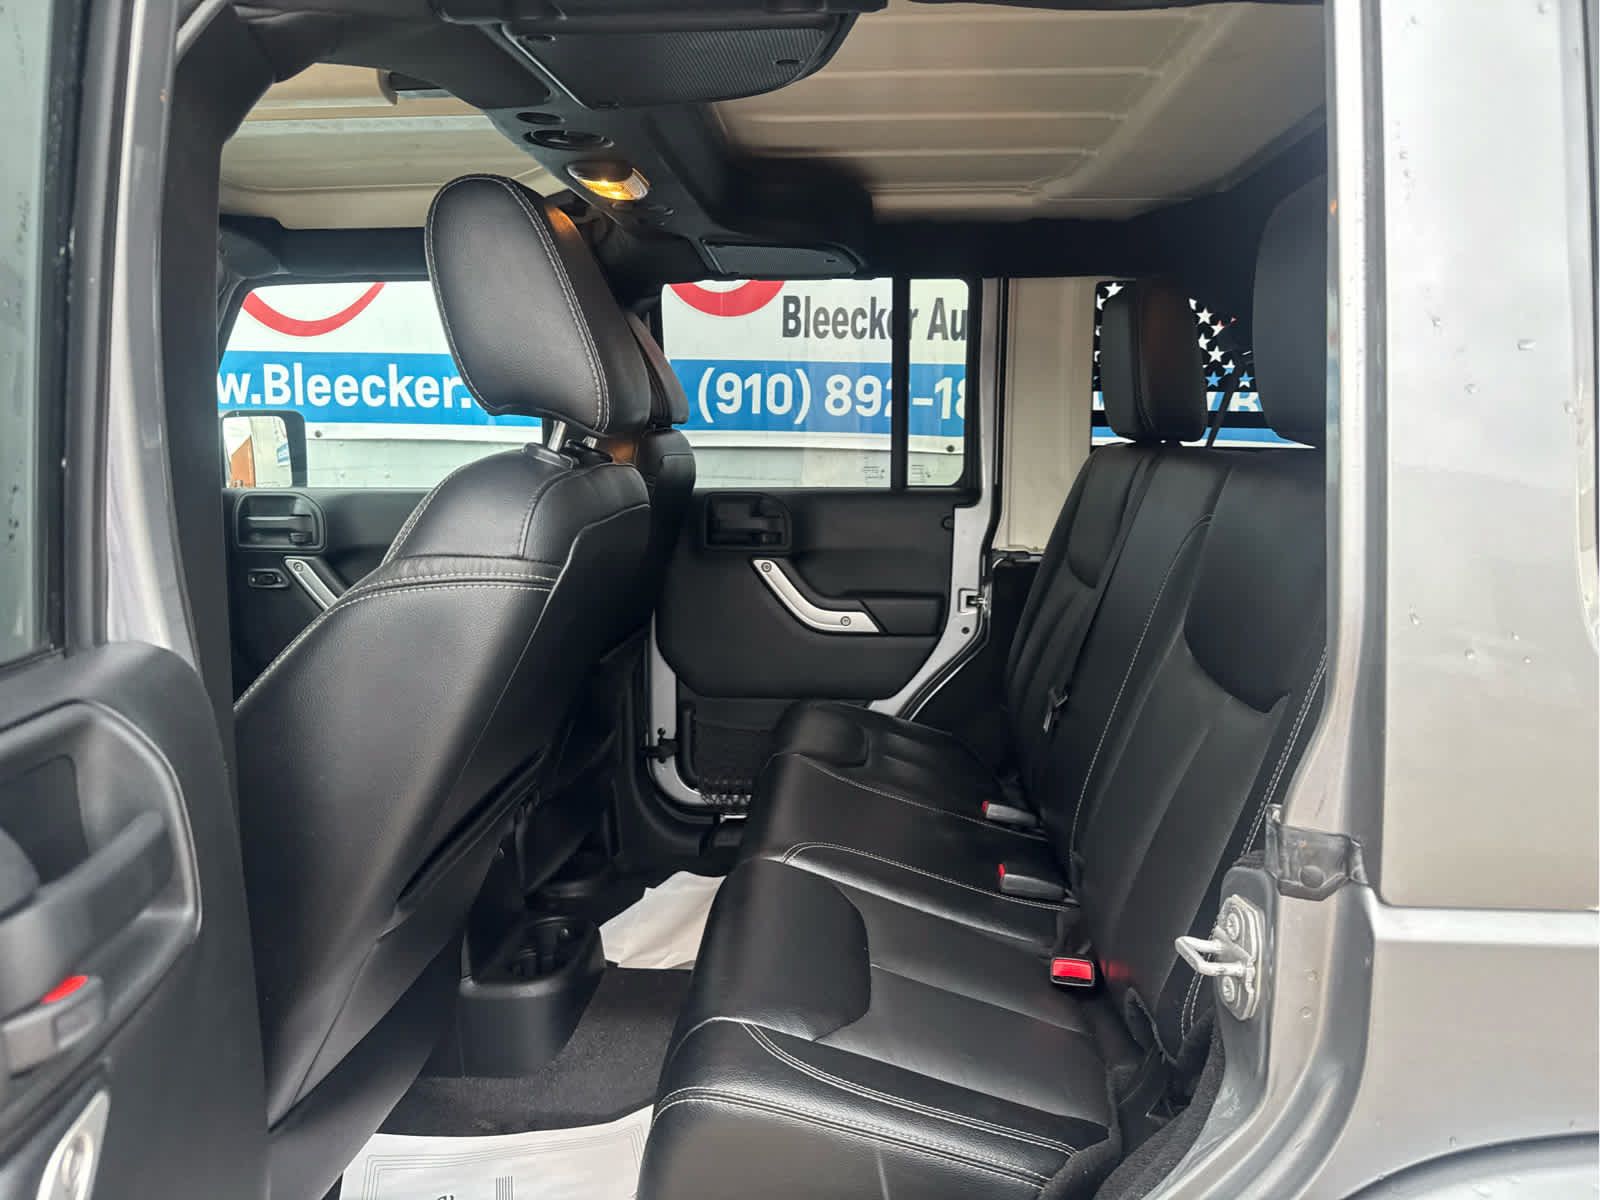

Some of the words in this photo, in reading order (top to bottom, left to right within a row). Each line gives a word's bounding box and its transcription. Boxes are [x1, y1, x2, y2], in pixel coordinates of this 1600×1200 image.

[782, 295, 919, 340] Bleeckr
[927, 297, 967, 341] Au
[698, 367, 811, 424] (910)
